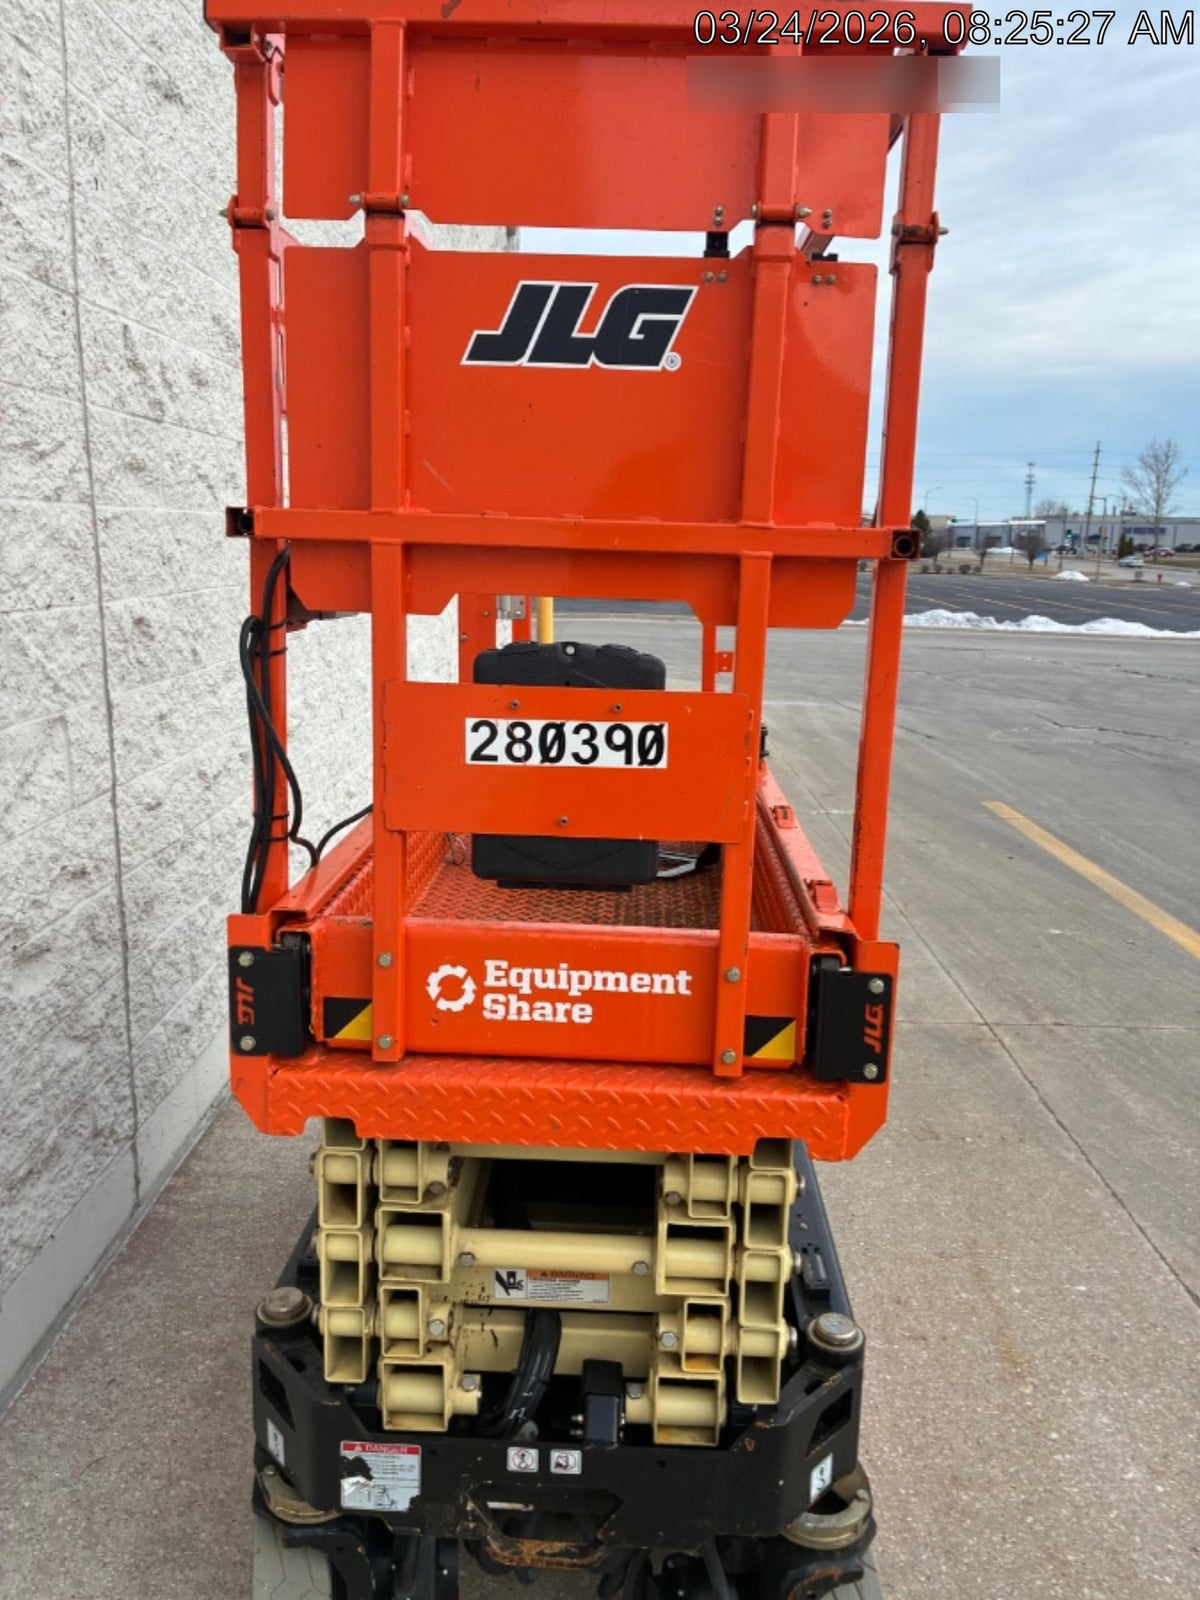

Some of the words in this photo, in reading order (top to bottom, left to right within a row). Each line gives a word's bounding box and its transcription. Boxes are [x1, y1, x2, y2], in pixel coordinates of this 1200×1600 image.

[469, 719, 665, 767] 280390
[235, 976, 256, 1026] JLG
[484, 959, 692, 996] Equipment
[482, 993, 593, 1024] Share
[863, 1003, 884, 1054] JLG
